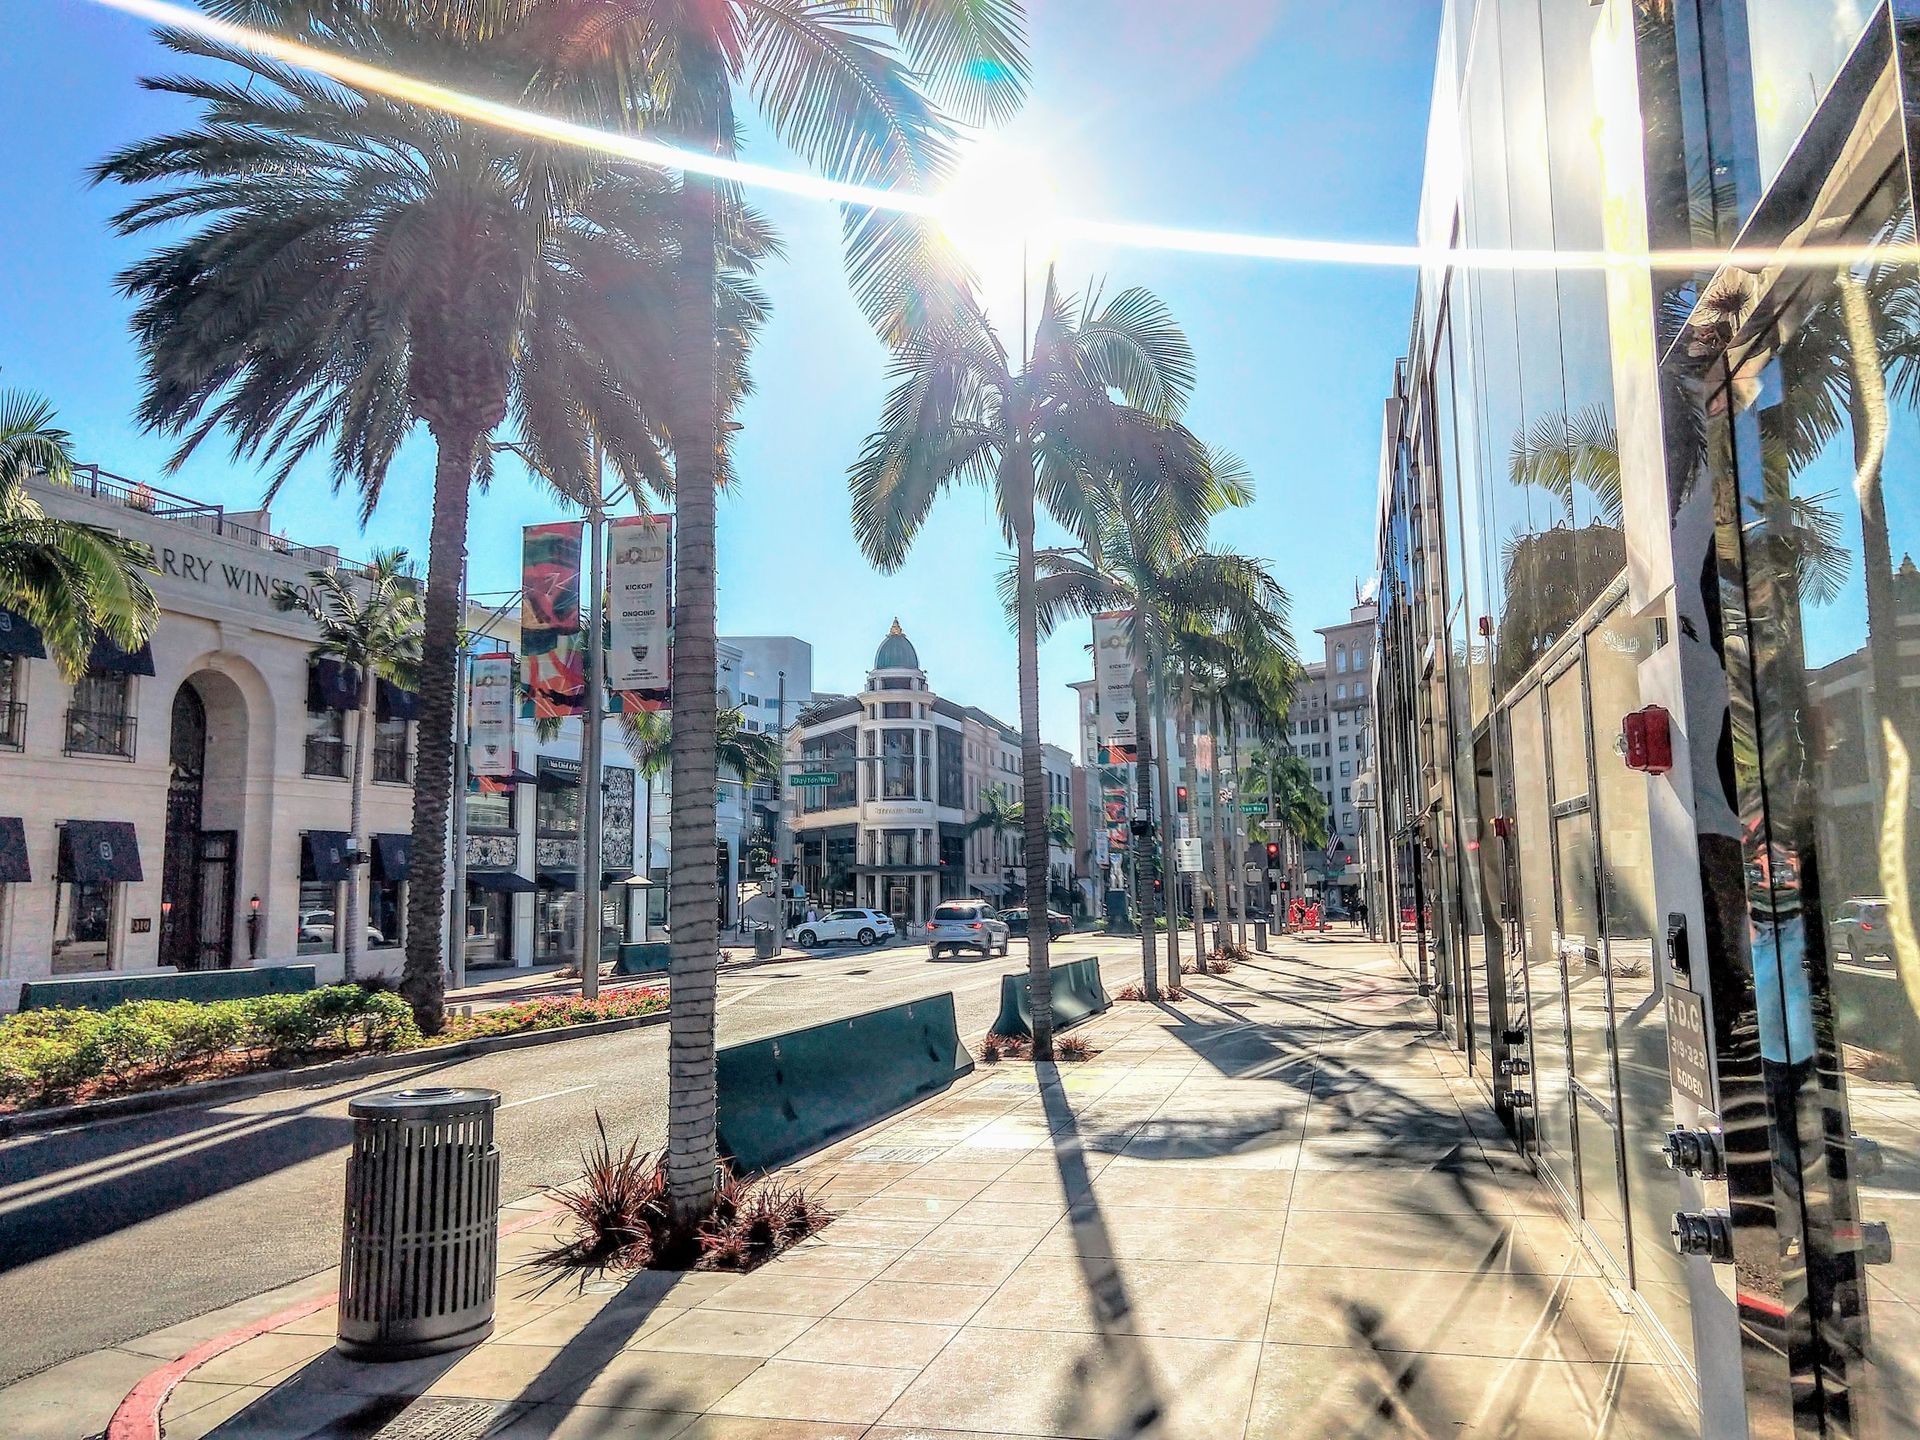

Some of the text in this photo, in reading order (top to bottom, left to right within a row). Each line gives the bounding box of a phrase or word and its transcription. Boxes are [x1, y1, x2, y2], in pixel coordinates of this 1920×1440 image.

[625, 583, 653, 591] KICKOFF
[622, 609, 656, 617] ONGOING
[820, 776, 835, 784] Way
